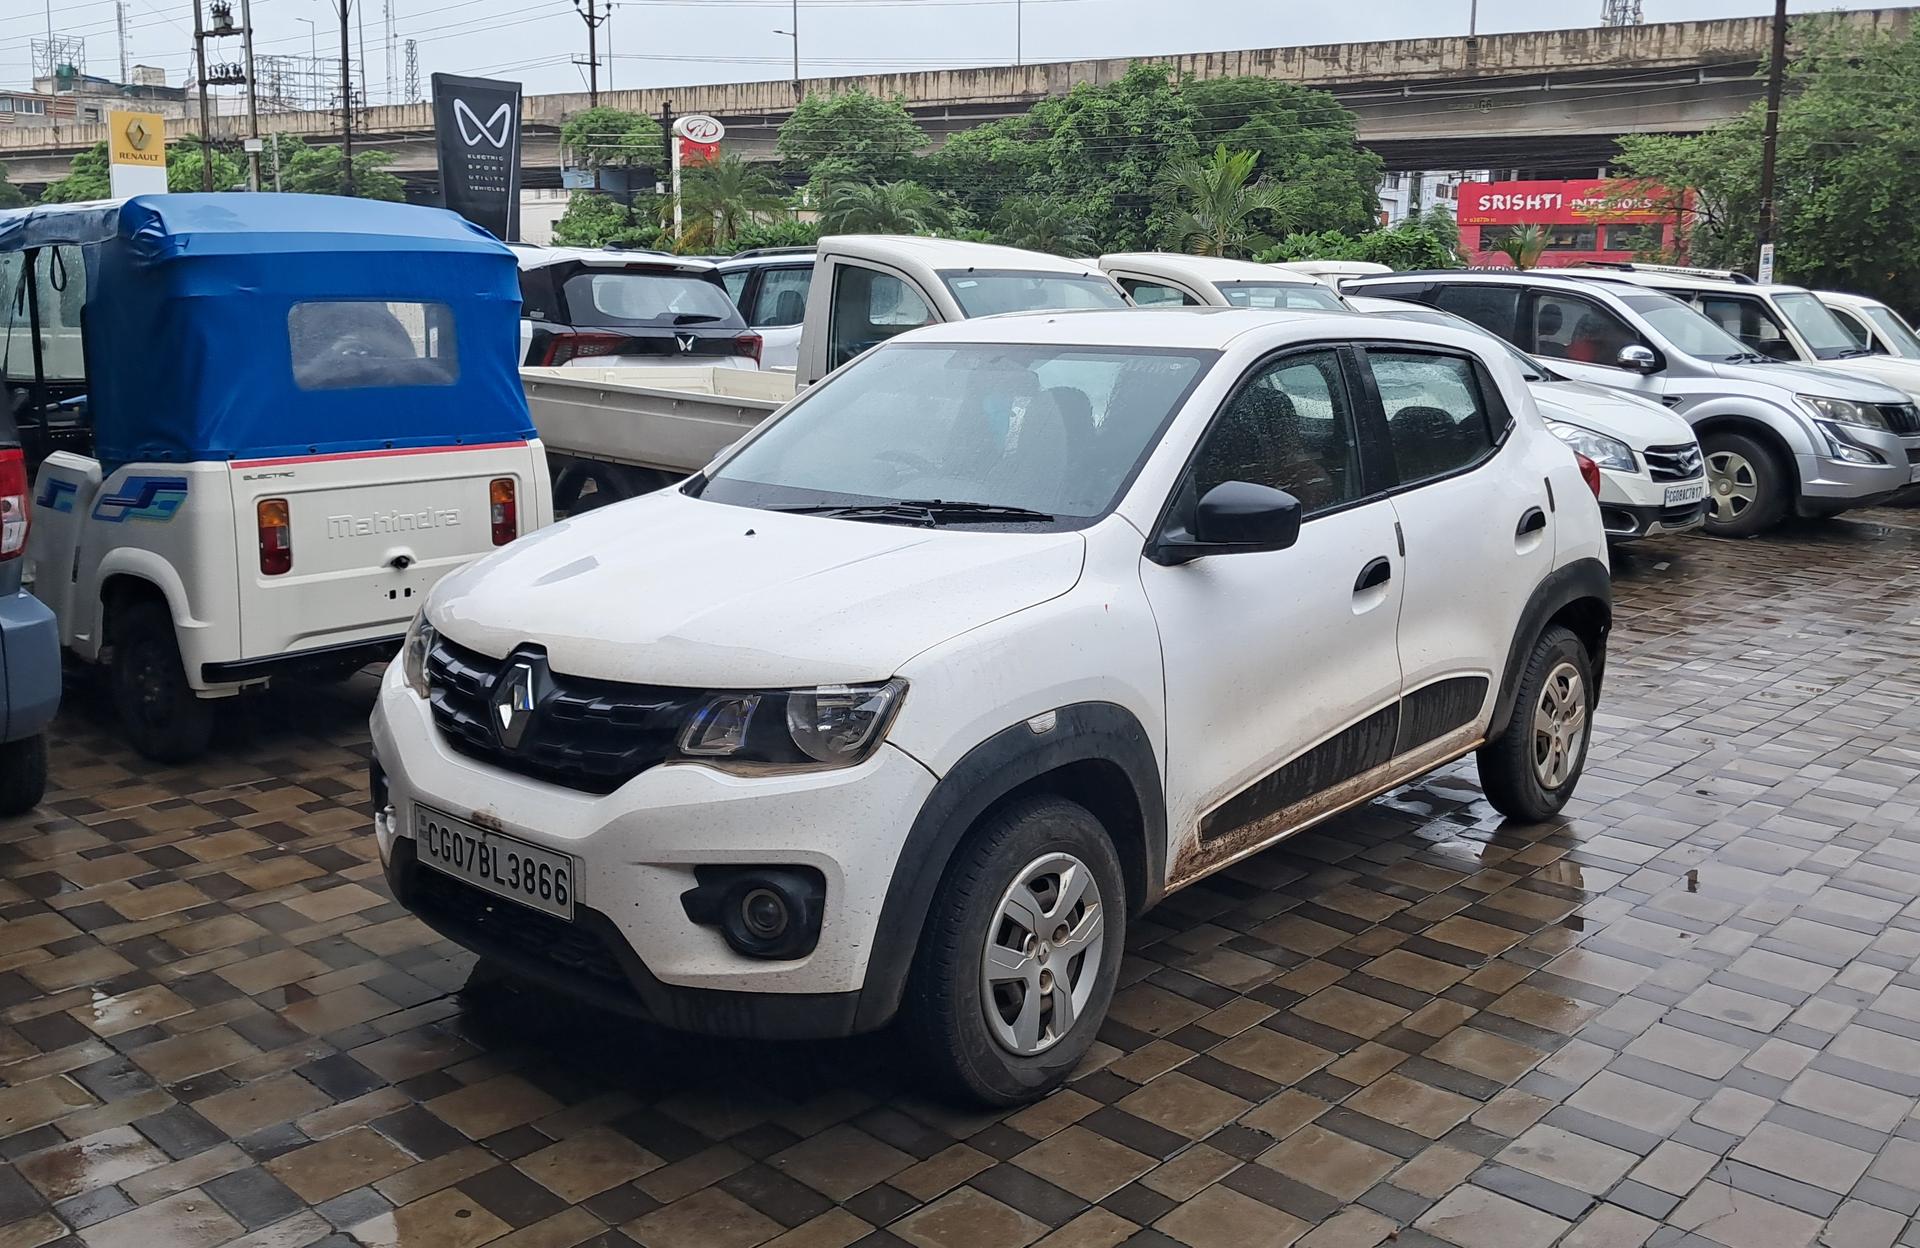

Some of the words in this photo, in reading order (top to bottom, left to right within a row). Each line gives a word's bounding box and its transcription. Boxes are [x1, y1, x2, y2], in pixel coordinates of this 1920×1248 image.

[119, 152, 160, 161] RENAULT
[467, 153, 504, 161] ELECTRIC
[468, 174, 504, 182] UTILITY
[1478, 193, 1563, 211] SRISHTI
[1571, 198, 1653, 210] INTEIORS
[243, 471, 296, 480] ELECTRIC
[428, 822, 568, 906] CG07BL3866
